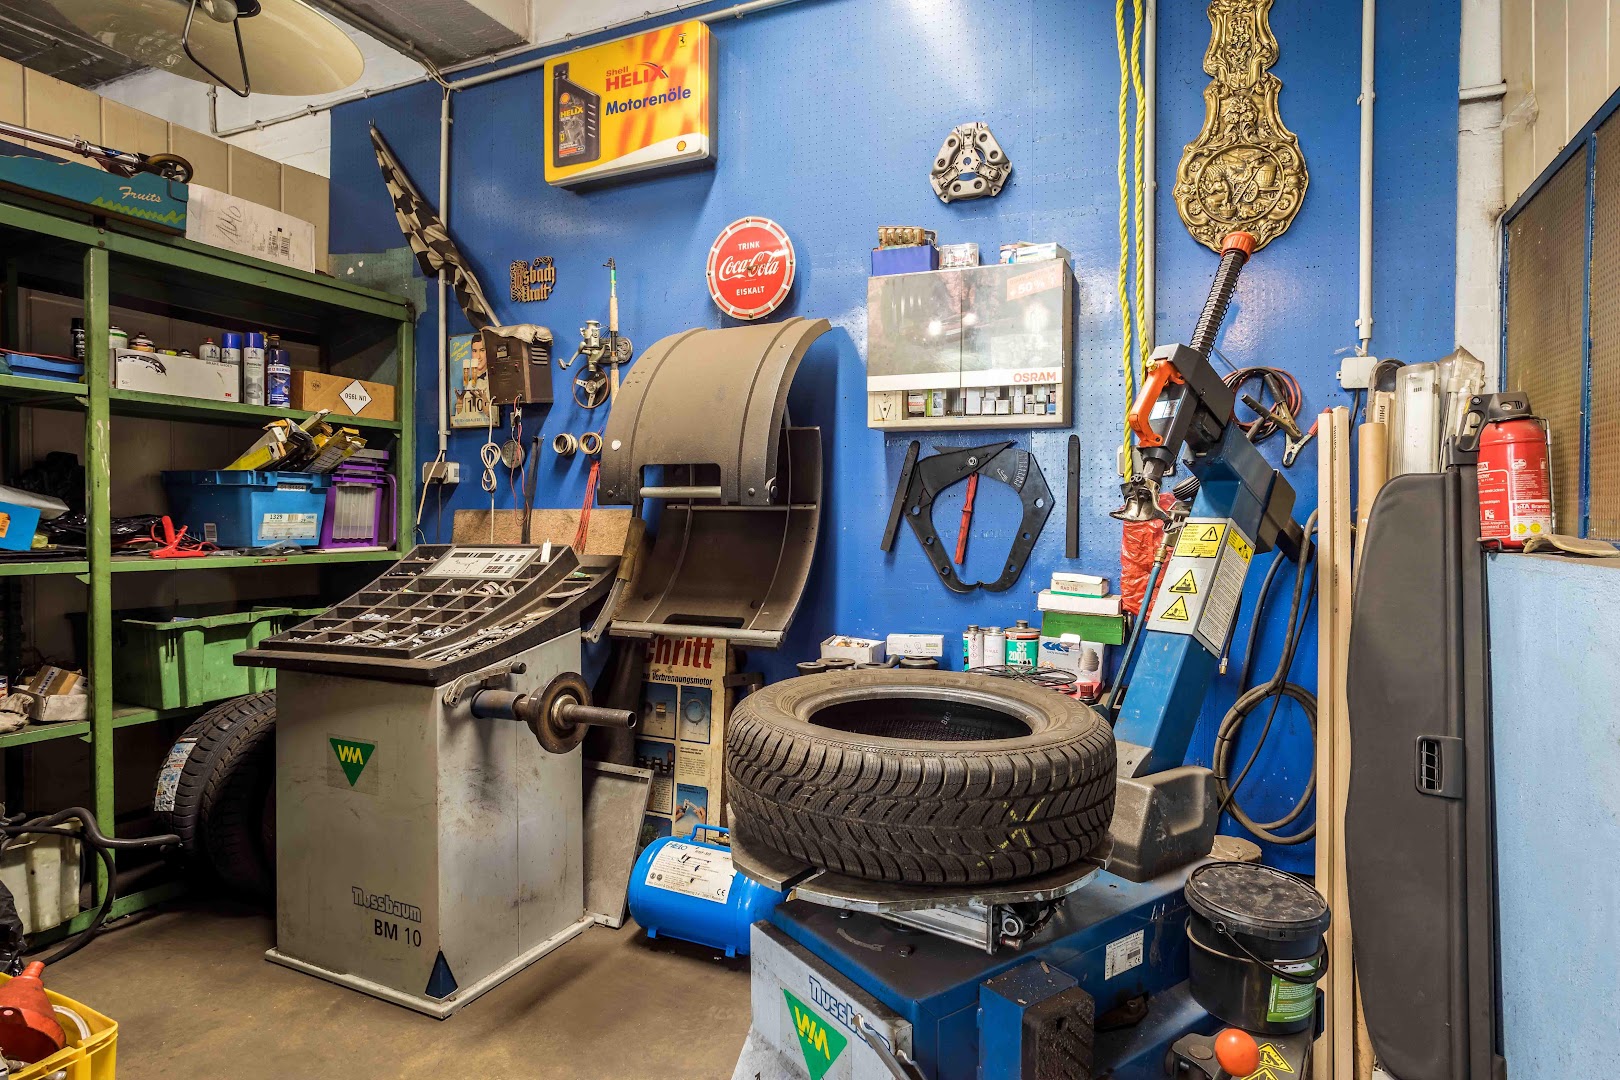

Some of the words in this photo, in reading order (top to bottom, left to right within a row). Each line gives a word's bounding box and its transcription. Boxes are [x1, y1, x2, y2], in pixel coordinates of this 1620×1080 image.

[606, 66, 628, 77] Shell
[606, 63, 667, 92] HELIX
[606, 86, 691, 116] Motorenöle
[560, 106, 584, 118] HELIX
[119, 186, 161, 203] Fruits
[738, 241, 760, 250] TRINK
[719, 250, 780, 281] Coca-Cola
[736, 286, 765, 296] EISKALT
[1013, 371, 1056, 382] OSRAM
[1016, 642, 1027, 652] SC
[1008, 650, 1027, 661] 2000
[652, 672, 713, 686] Verbrennungsmotor
[352, 886, 421, 923] Nussbaum
[375, 918, 398, 941] BM
[405, 927, 422, 947] 10
